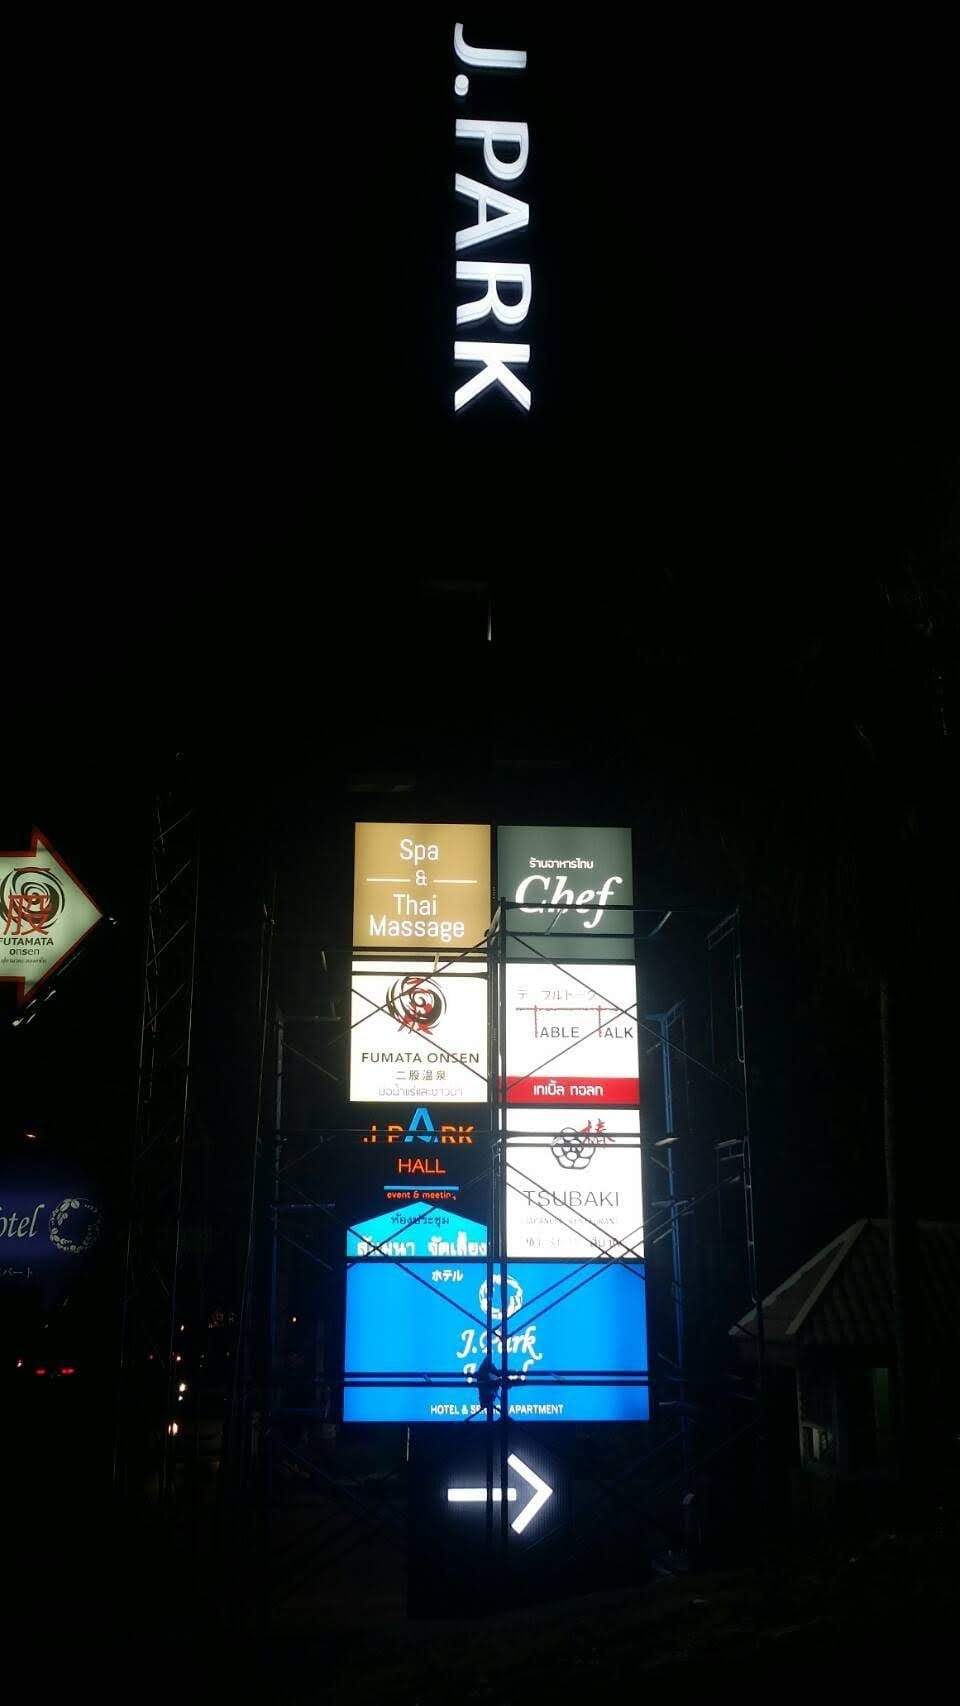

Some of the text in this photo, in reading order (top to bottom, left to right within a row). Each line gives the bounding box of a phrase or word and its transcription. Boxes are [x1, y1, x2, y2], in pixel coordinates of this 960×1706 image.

[453, 22, 532, 413] J.PARK
[399, 838, 439, 865] Spa
[529, 857, 594, 869] ร้านอาหารไทย
[415, 870, 428, 886] &
[393, 894, 437, 916] Thai
[515, 875, 623, 929] Chef
[369, 915, 465, 942] Massage
[9, 948, 40, 957] onsen
[361, 1052, 480, 1064] FUMATA ONSEN
[397, 1158, 446, 1174] HALL
[386, 1192, 411, 1200] event
[413, 1191, 420, 1199] &
[523, 1190, 620, 1207] TSUBAKI
[431, 1269, 464, 1282] ホテル
[430, 1404, 460, 1415] HOTEL
[461, 1404, 469, 1415] &
[509, 1404, 564, 1415] APARTMENT
